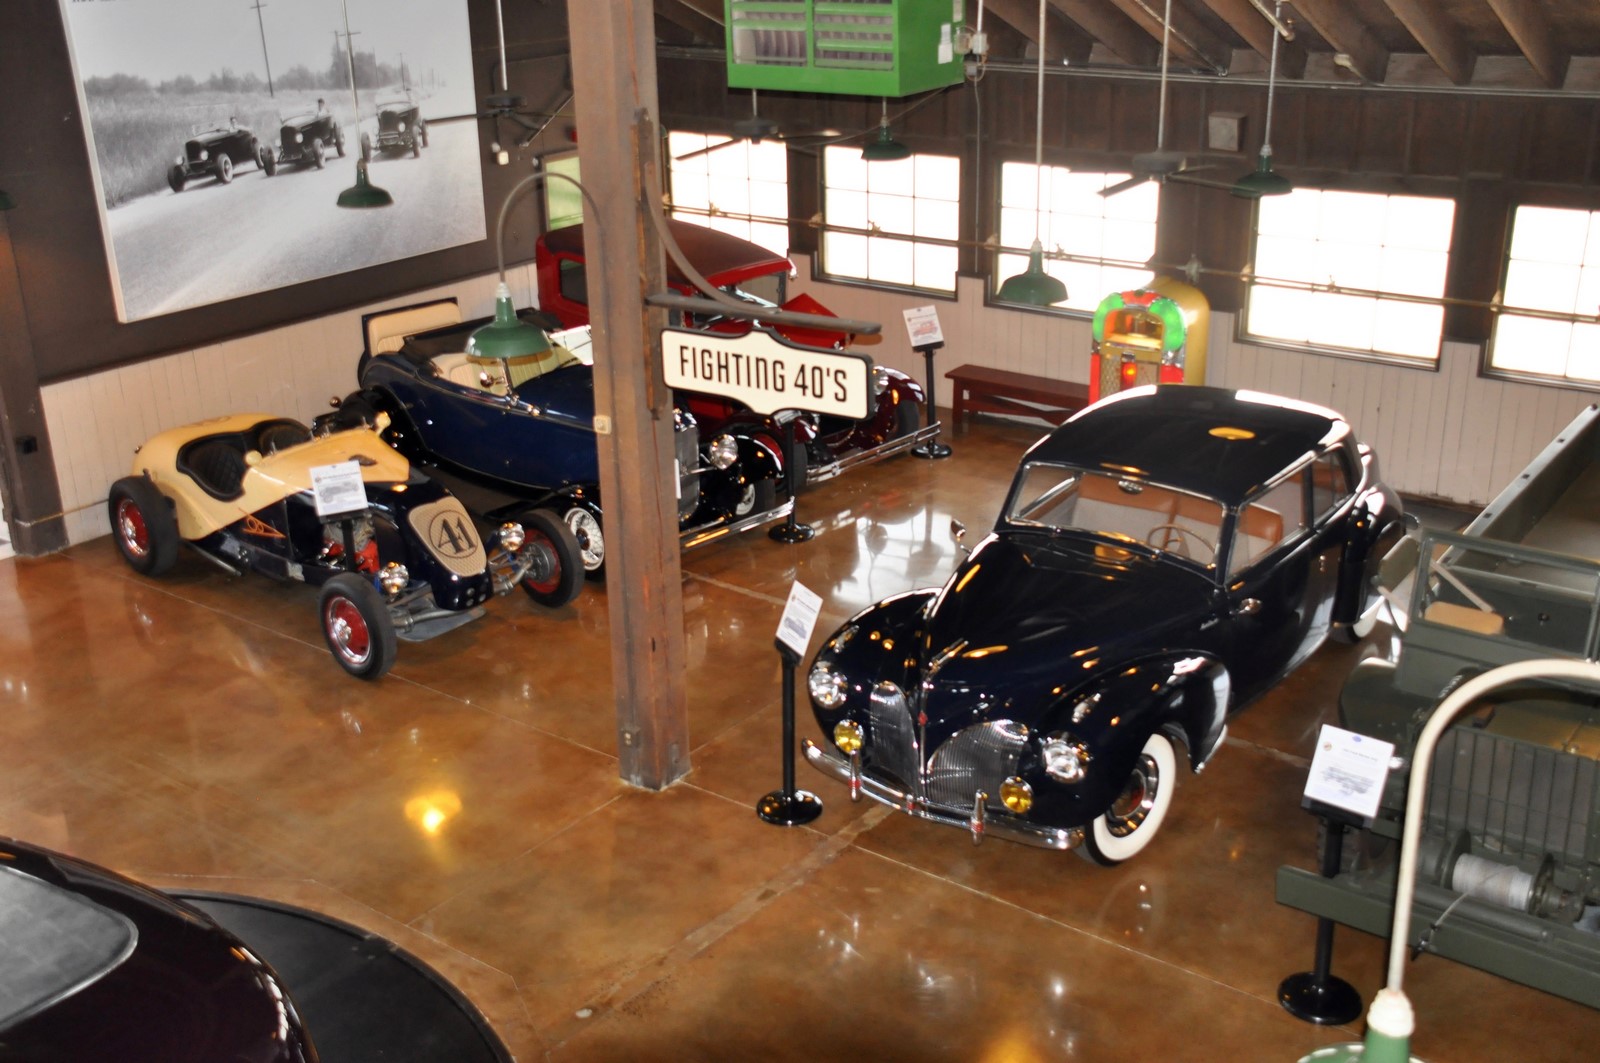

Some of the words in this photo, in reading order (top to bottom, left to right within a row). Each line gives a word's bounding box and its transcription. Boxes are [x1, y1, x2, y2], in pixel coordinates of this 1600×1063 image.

[679, 345, 785, 393] FIGHTING
[794, 364, 847, 402] 40'S
[437, 515, 478, 555] 41
